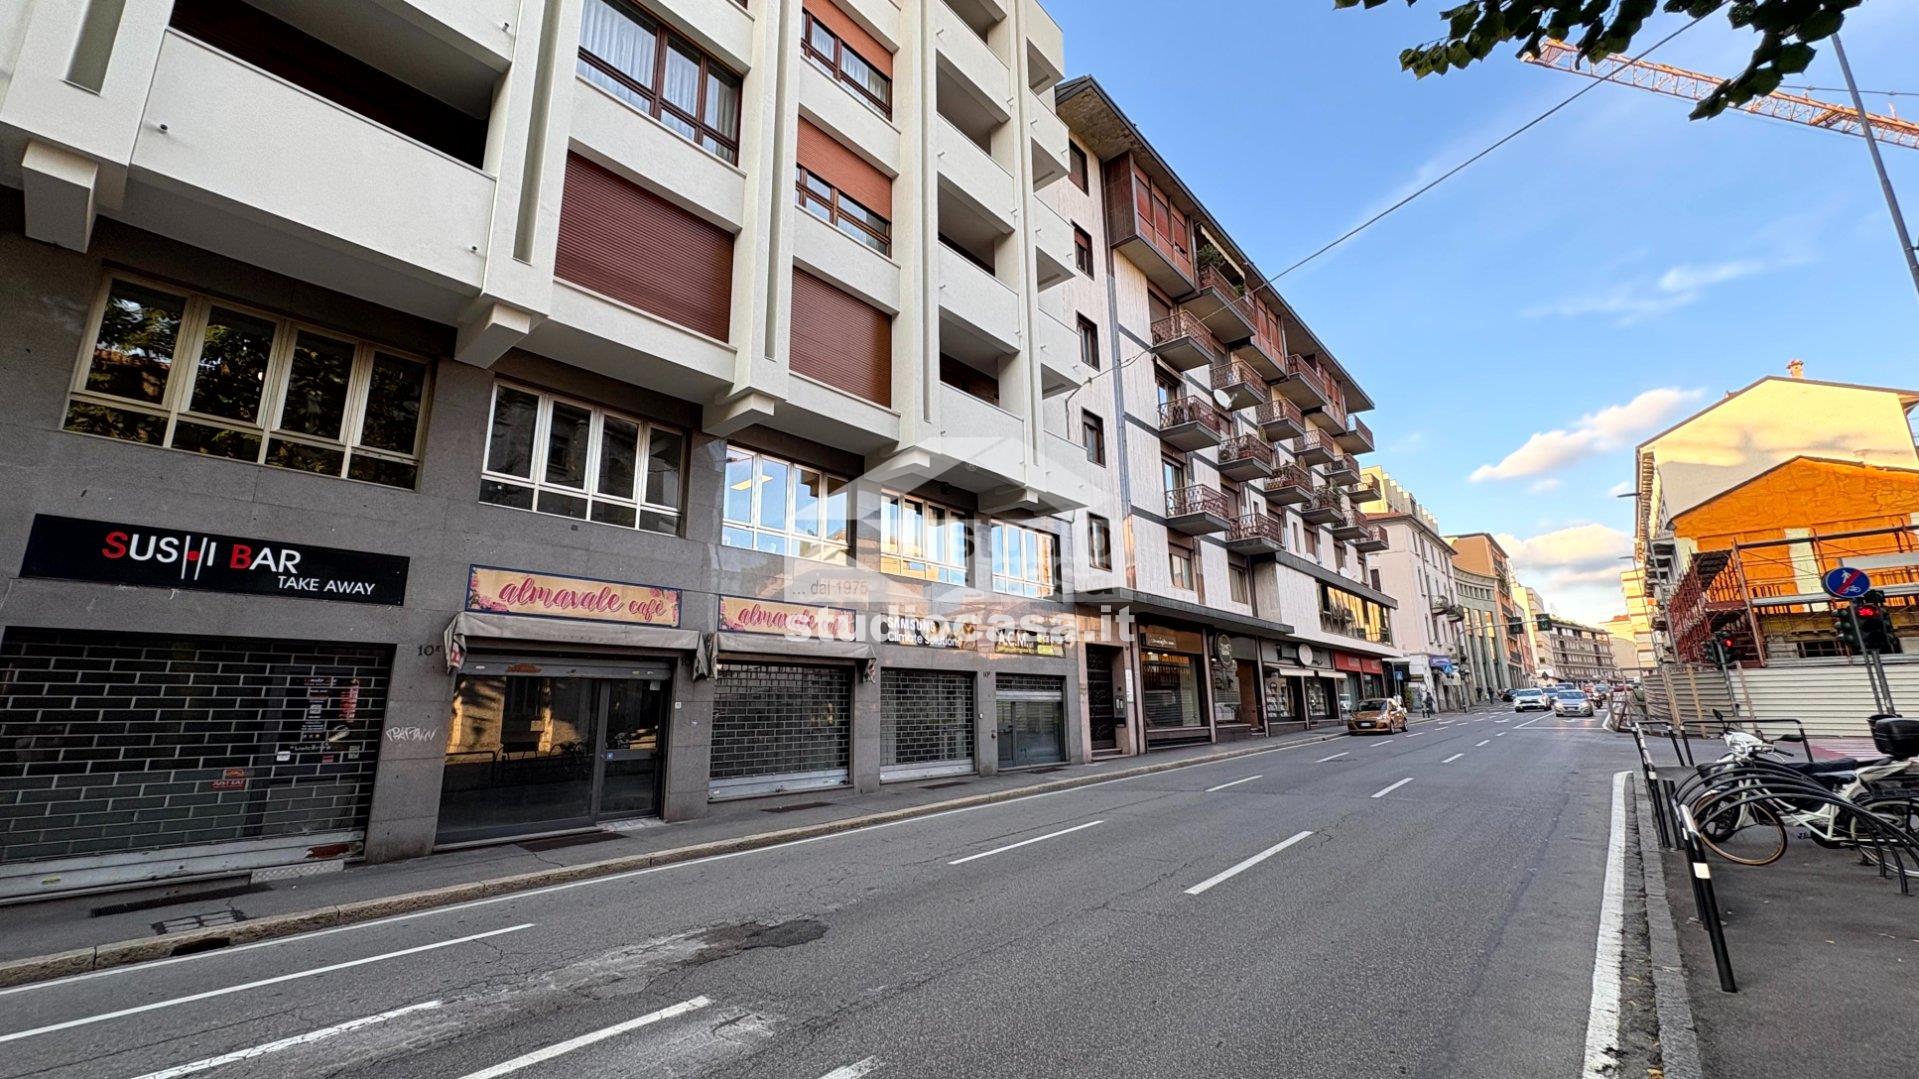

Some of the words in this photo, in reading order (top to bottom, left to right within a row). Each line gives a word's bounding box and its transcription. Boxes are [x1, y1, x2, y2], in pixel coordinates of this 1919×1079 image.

[102, 530, 217, 581] SUSHI
[230, 543, 302, 575] BAR
[277, 575, 319, 592] TAKE
[323, 579, 376, 596] AWAY
[498, 576, 625, 614] almavale
[887, 615, 936, 634] SAMSUNG
[887, 630, 924, 645] Climate
